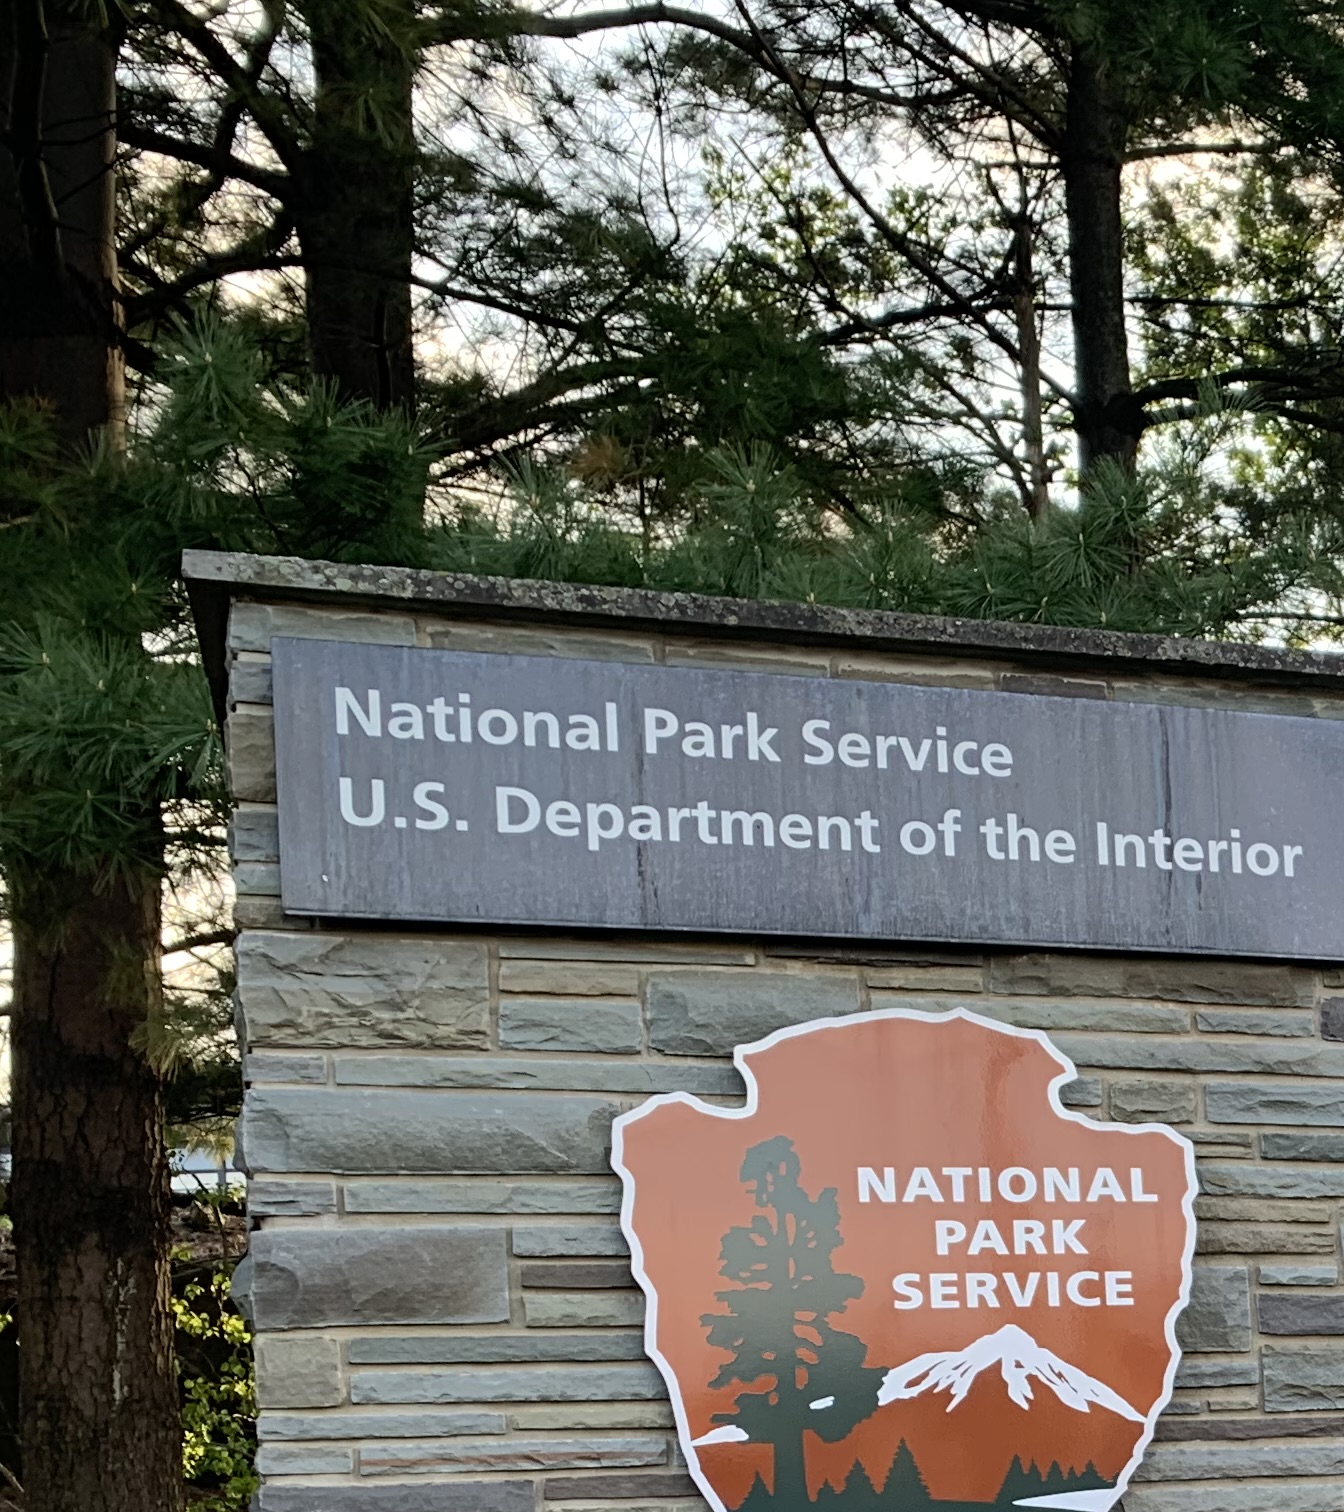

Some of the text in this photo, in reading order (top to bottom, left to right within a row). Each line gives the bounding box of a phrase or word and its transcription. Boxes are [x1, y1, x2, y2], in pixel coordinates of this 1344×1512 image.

[335, 687, 1013, 777] National Park Service
[339, 777, 1302, 877] U.S. Department of the Interior
[858, 1167, 1158, 1202] NATIONAL
[935, 1220, 1088, 1255] PARK
[893, 1271, 1134, 1309] SERVICE
